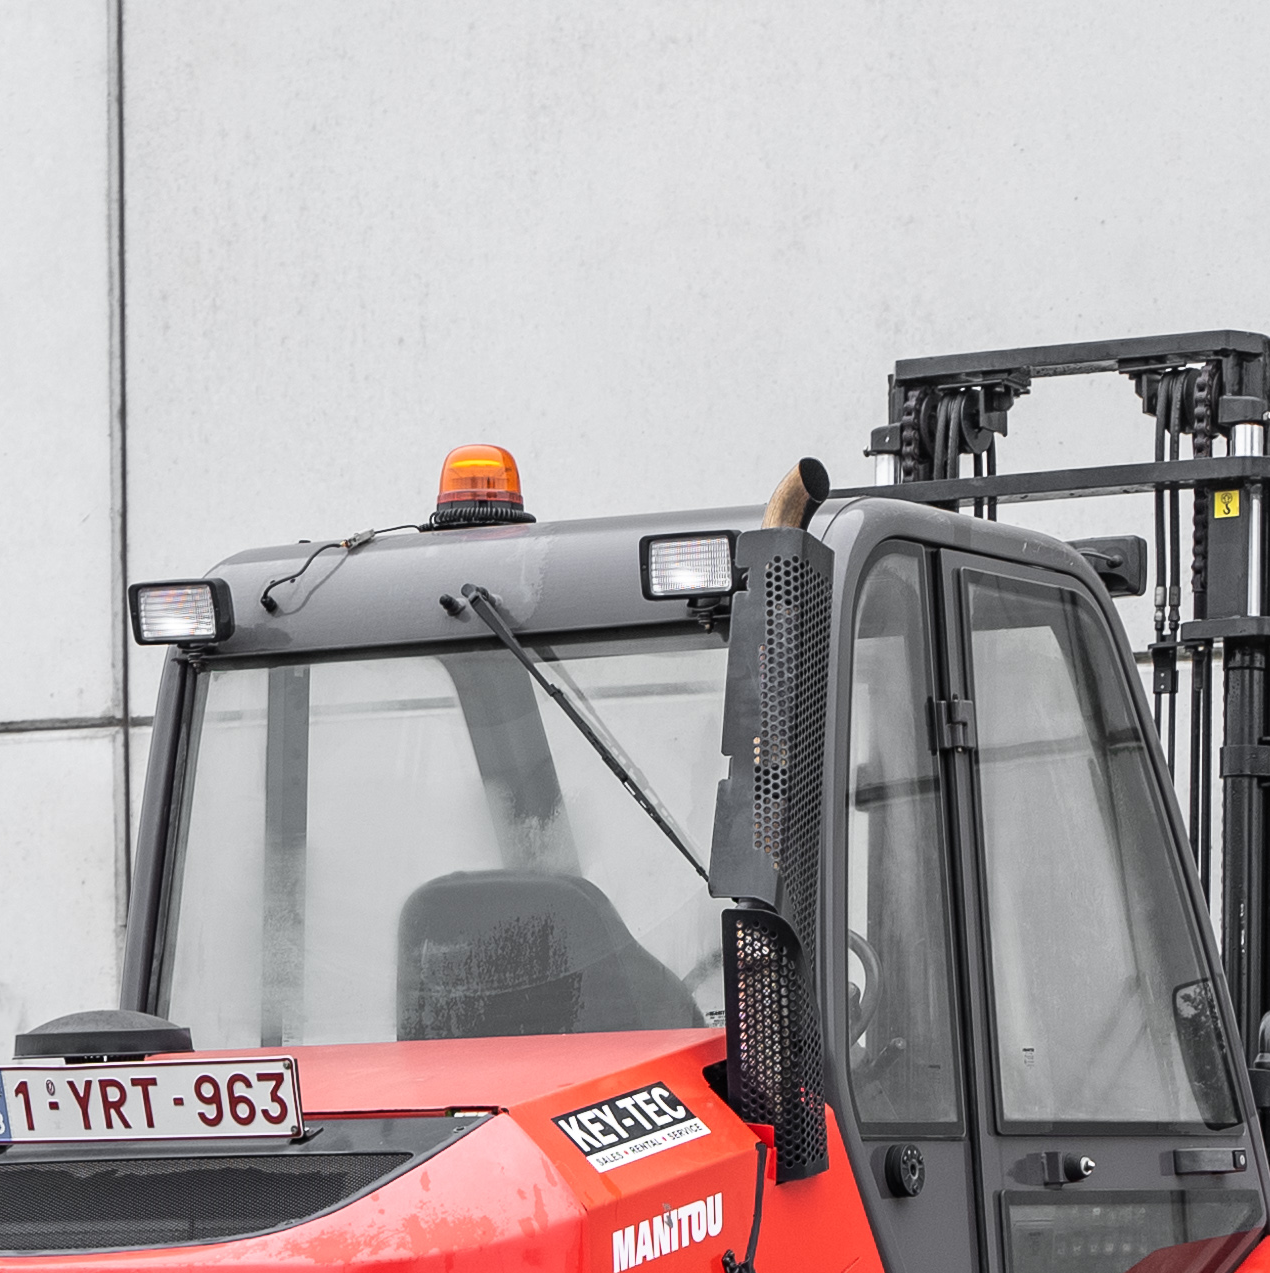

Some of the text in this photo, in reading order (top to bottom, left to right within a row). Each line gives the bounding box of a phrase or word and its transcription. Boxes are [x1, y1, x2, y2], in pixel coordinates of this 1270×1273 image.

[557, 1085, 687, 1153] KEY-TEC
[596, 1122, 704, 1167] SALES RENTAL SERVICE
[611, 1191, 723, 1273] MANITOU
